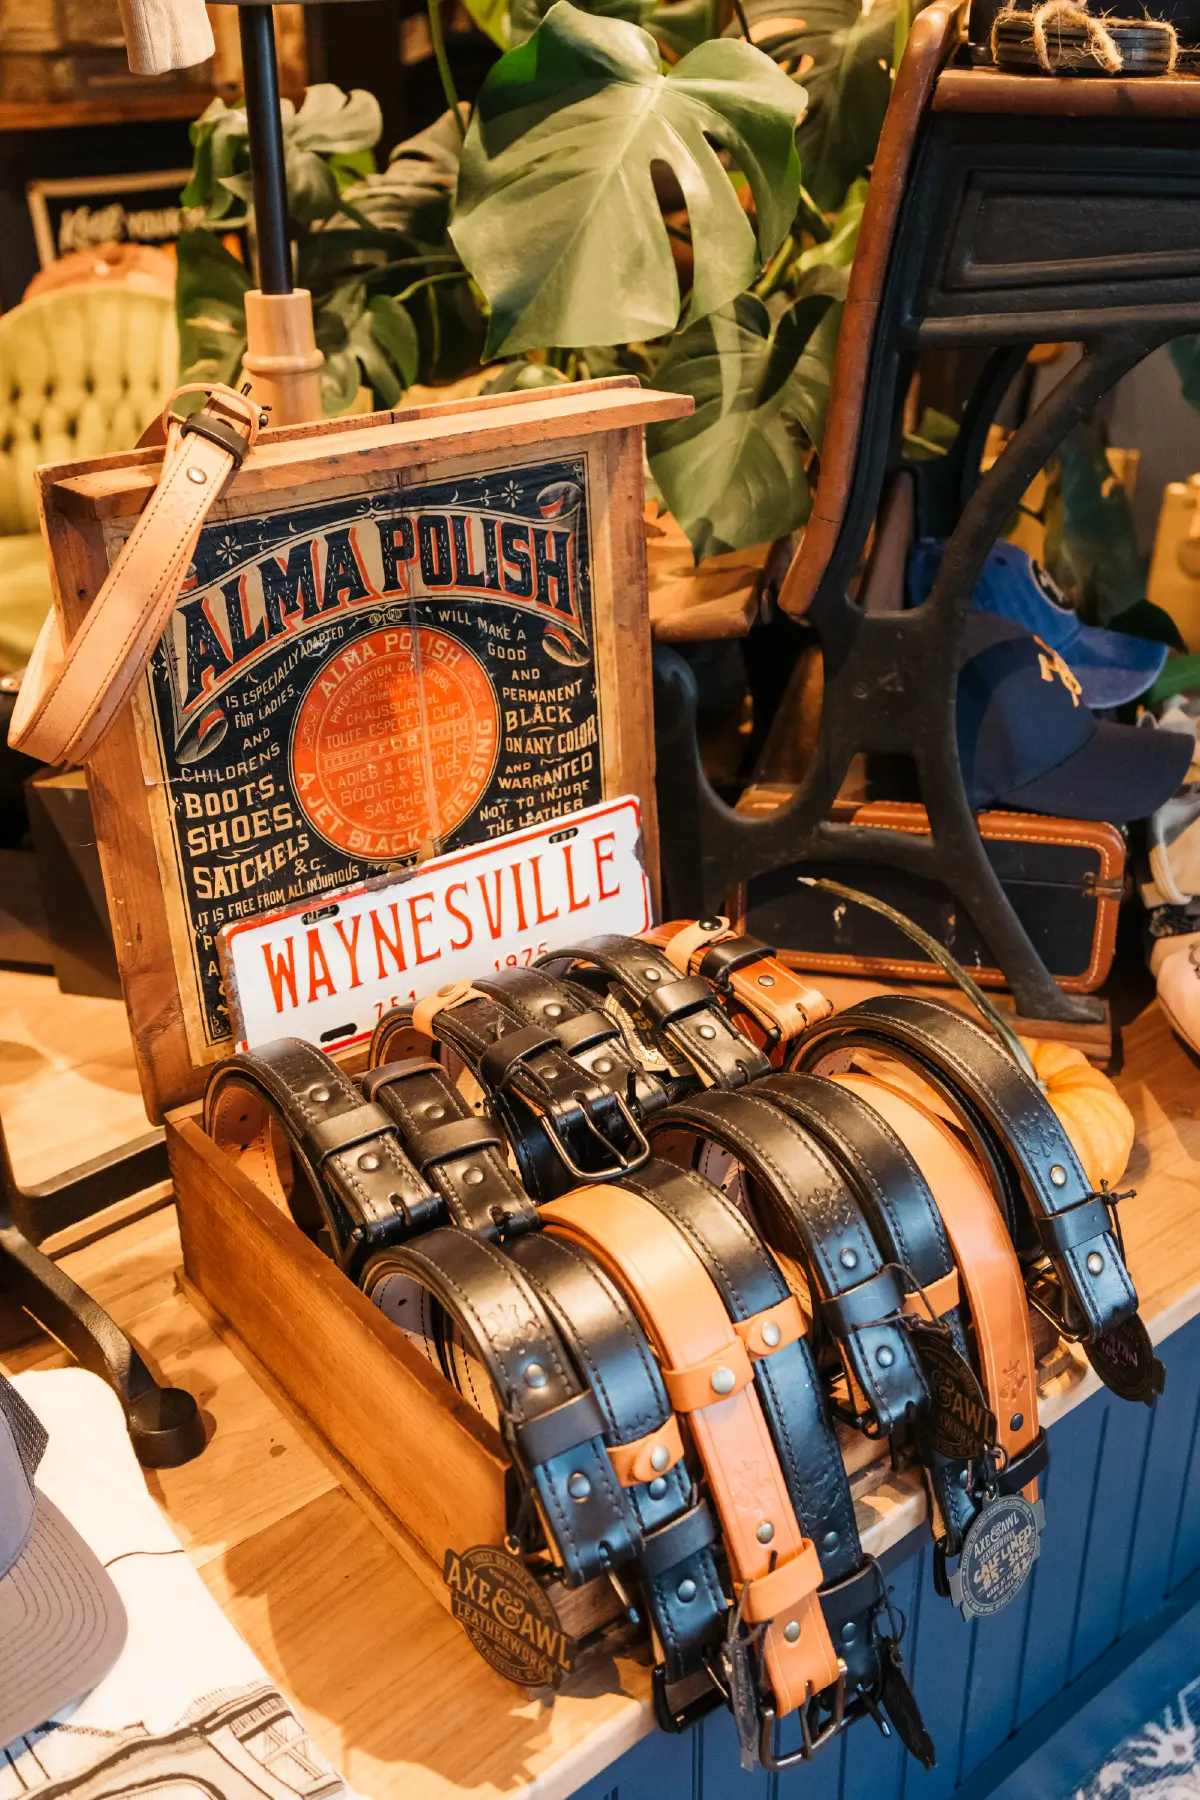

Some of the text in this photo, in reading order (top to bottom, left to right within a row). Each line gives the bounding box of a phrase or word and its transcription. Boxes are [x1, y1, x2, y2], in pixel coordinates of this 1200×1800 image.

[174, 514, 579, 714] ALMA POLISH
[438, 610, 526, 641] WILL MAKE A
[225, 626, 344, 708] IS ESPECIALLY ADAPTED
[318, 642, 376, 699] ALMA
[488, 642, 526, 661] GOOD
[330, 661, 392, 724] PREPARATION
[503, 679, 582, 703] PERMANENT
[512, 668, 540, 681] AND
[235, 684, 295, 729] FOR LADIES
[325, 731, 362, 749] TOUTE
[433, 702, 461, 721] CUIR
[505, 705, 573, 733] BLACK
[243, 728, 271, 750] AND
[379, 735, 419, 755] FOR
[506, 714, 597, 754] ON ANY COLOR
[181, 742, 281, 783] CHILDRENS
[328, 768, 378, 791] LADIES
[384, 761, 394, 774] &
[398, 776, 410, 789] &
[412, 760, 464, 786] SOES
[498, 751, 593, 790] WARRANTED
[505, 762, 531, 774] AND
[183, 774, 285, 819] BOOTS.
[299, 719, 493, 853] A JET BLACK RESSING
[480, 780, 590, 821] NOT TO INJURE
[487, 798, 583, 837] THE LEATHER
[193, 833, 310, 899] SATCHELS
[198, 862, 360, 926] IT IS FREE FROM ALL INJURIOUS
[261, 831, 620, 1013] WAYNESVILLE
[447, 1556, 491, 1610] AXE
[492, 1588, 525, 1630] &
[519, 1613, 571, 1671] AWL
